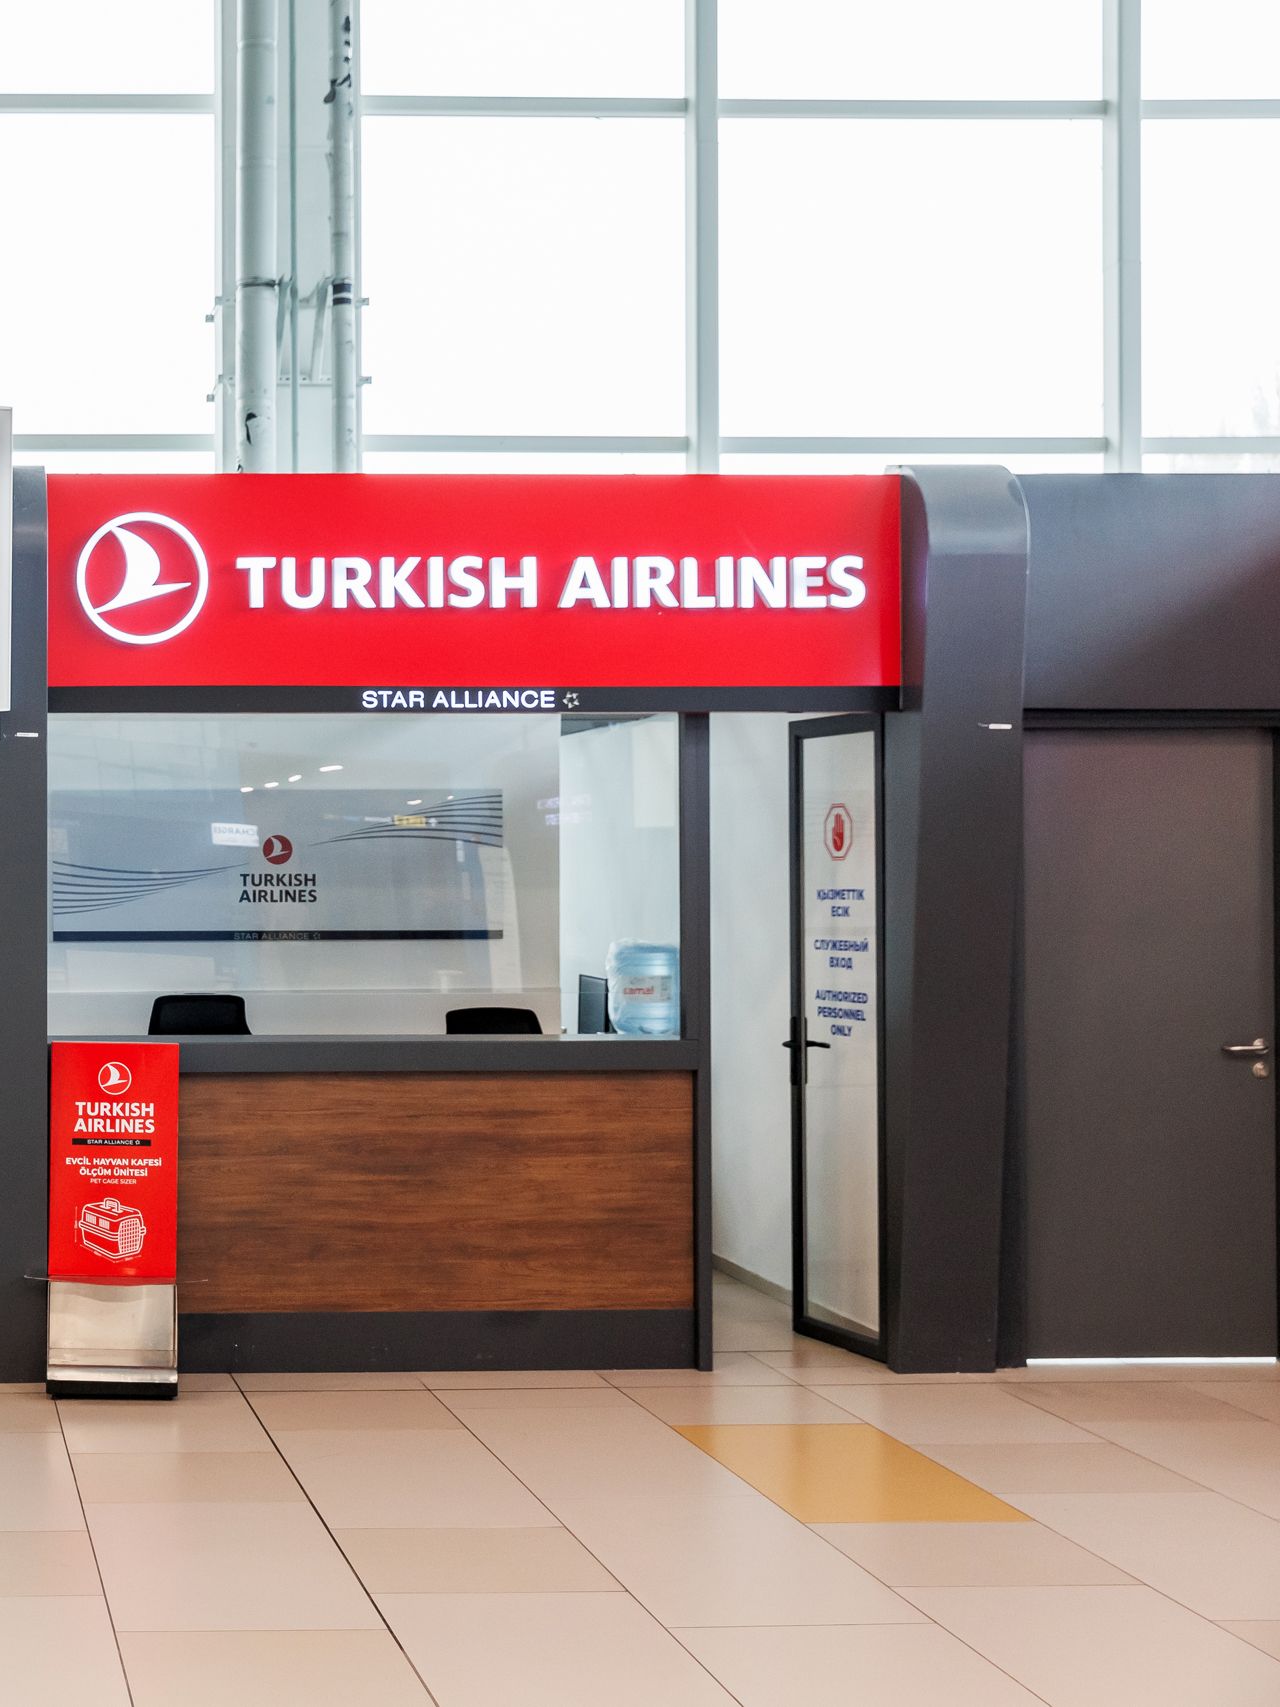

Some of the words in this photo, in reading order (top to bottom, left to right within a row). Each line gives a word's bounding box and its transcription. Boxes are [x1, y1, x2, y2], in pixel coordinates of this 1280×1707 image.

[235, 554, 539, 609] TURKISH
[557, 554, 867, 609] AIRLINES
[361, 689, 425, 709] STAR
[432, 689, 556, 709] ALLIANCE
[239, 873, 317, 887] TURKISH
[238, 889, 318, 903] AIRLINES
[233, 932, 259, 941] STAR
[261, 932, 310, 941] ALLIANCE
[814, 938, 869, 952] СЛУЖЕБНЫЙ
[829, 956, 853, 970] ВХОД
[815, 989, 869, 1004] AUTHORIZED
[817, 1006, 866, 1021] PERSONNEL
[830, 1024, 853, 1037] ONLY
[75, 1101, 155, 1117] TURKISH
[74, 1118, 156, 1134] AIRLINES
[65, 1156, 91, 1166] EVCİL
[93, 1158, 129, 1166] HAYVAN
[131, 1157, 162, 1167] KAFESİ
[79, 1166, 112, 1177] ÖLÇÜM
[113, 1167, 148, 1177] ÜNİTESİ
